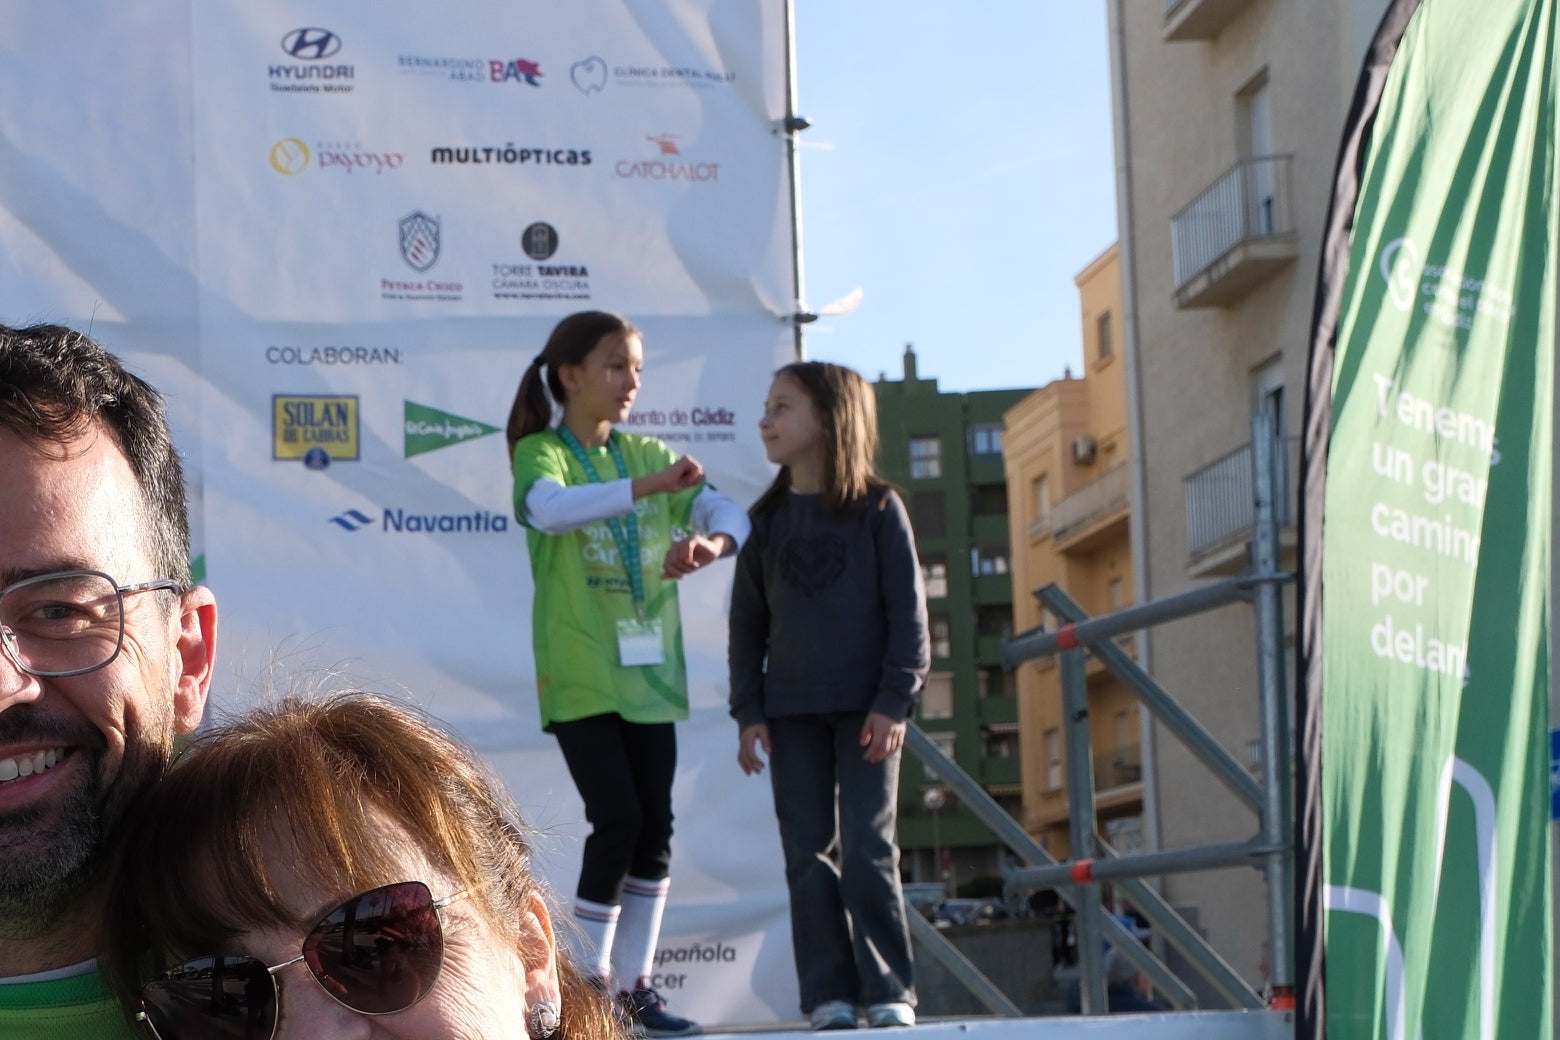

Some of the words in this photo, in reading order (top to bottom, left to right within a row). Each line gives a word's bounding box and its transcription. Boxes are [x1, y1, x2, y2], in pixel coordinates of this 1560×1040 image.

[268, 65, 355, 79] HYUNDAI
[1372, 442, 1414, 486] un
[383, 508, 509, 534] Navantia
[1371, 562, 1429, 606] por
[653, 942, 736, 967] pañola
